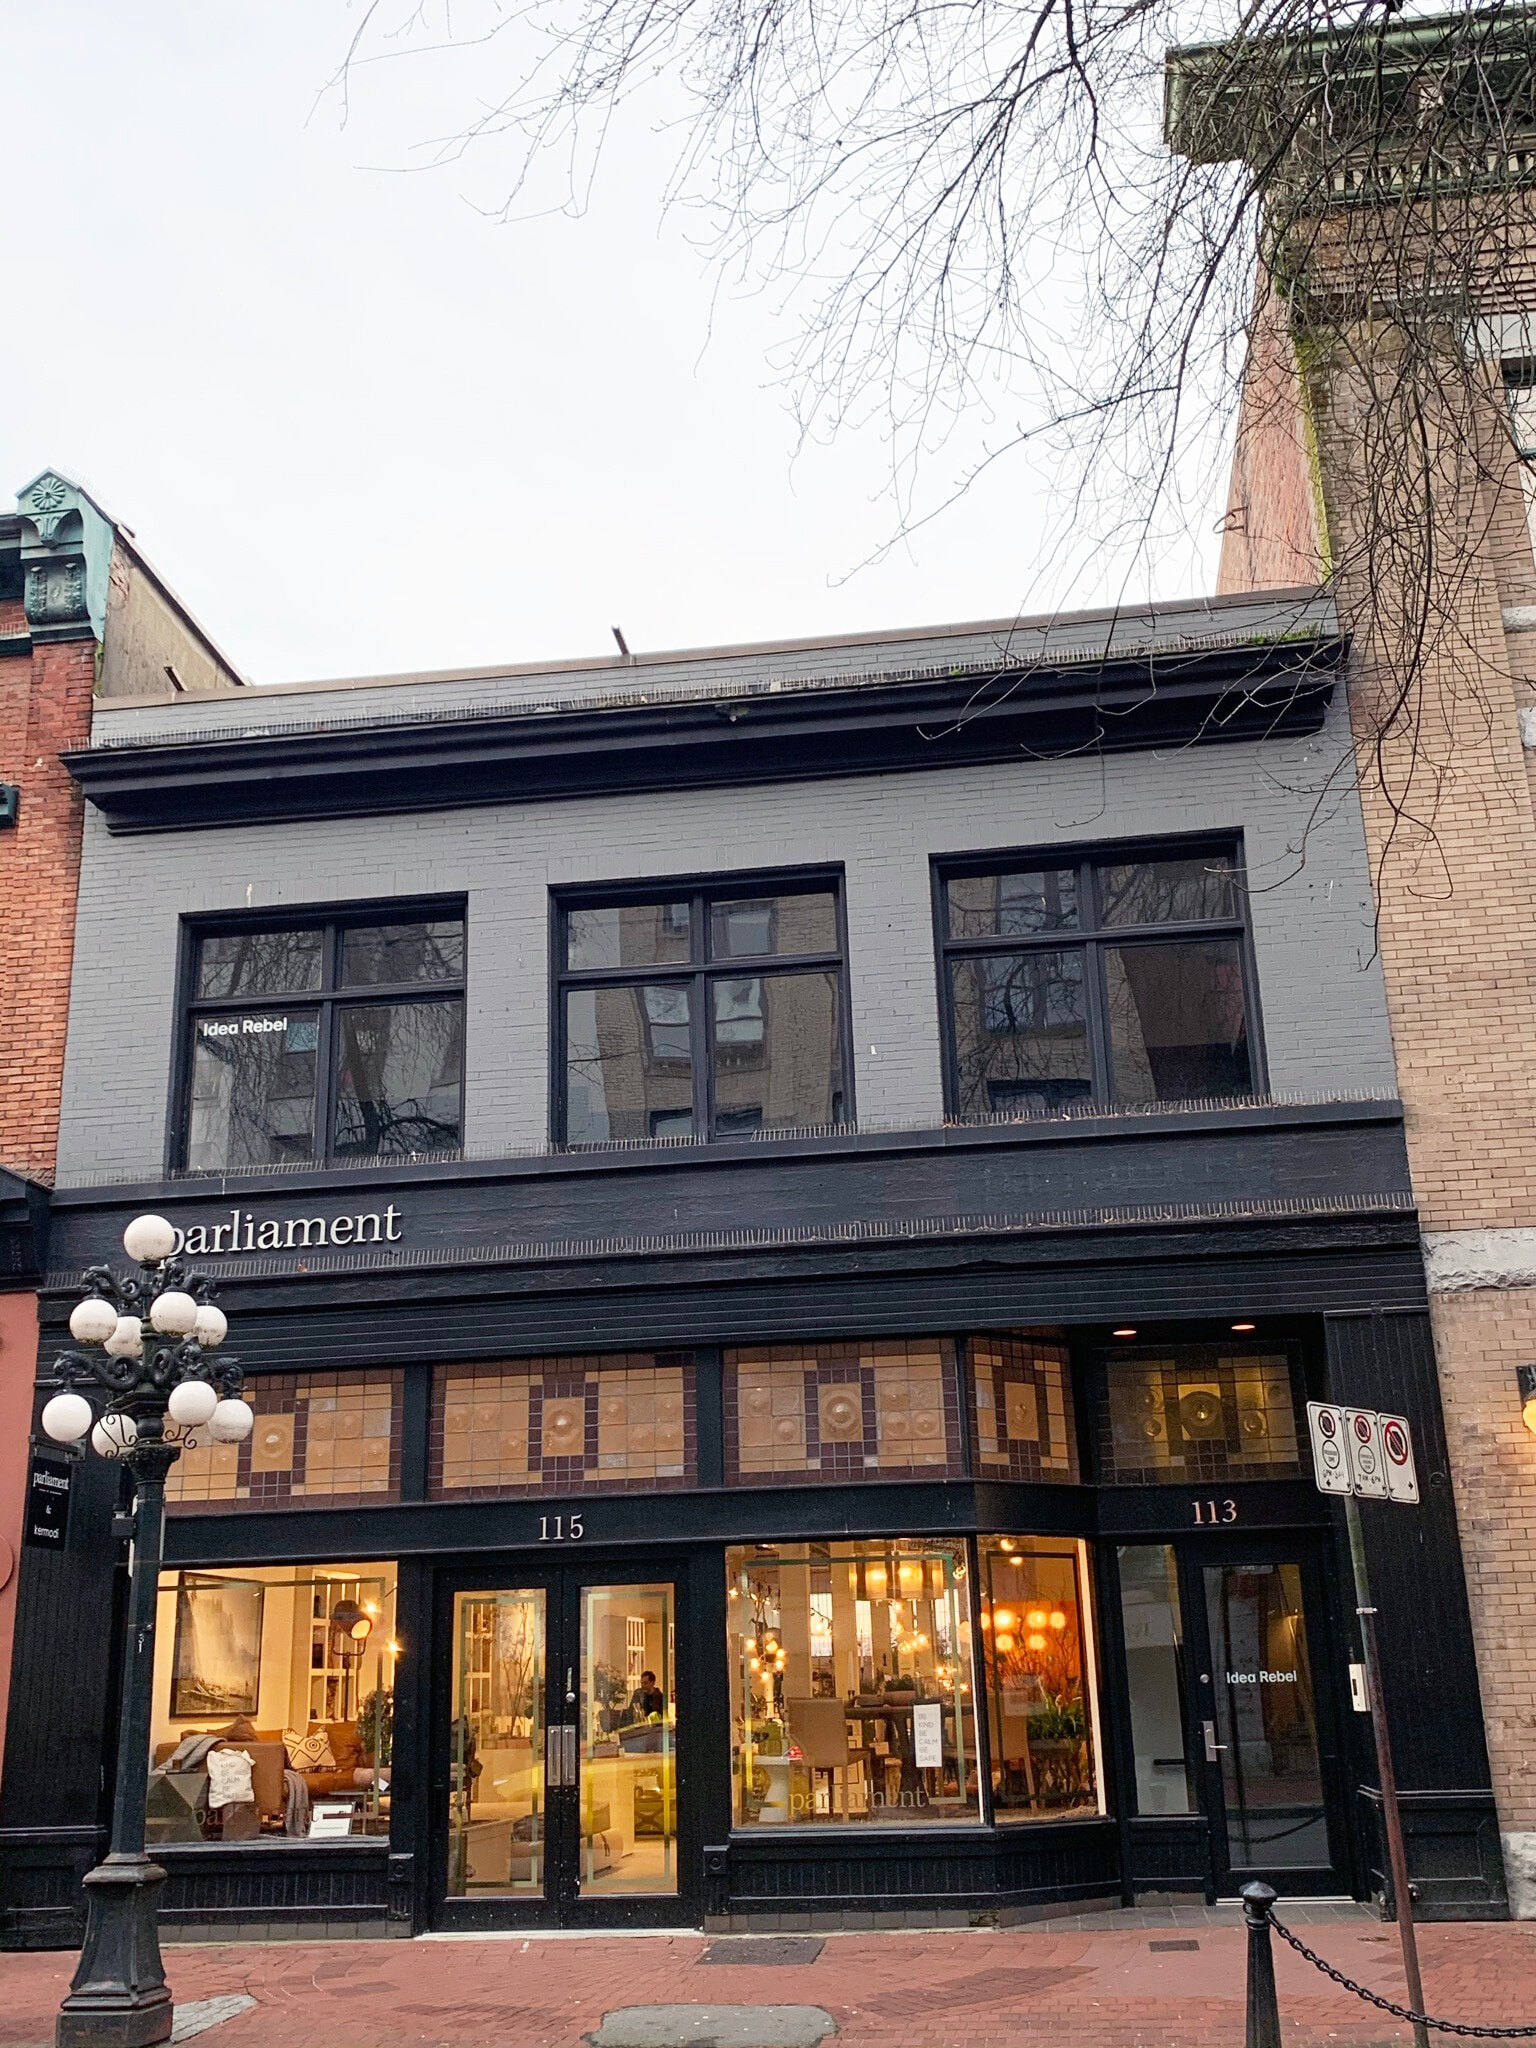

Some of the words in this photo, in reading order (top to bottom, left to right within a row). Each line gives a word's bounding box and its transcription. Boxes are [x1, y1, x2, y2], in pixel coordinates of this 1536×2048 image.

[203, 1022, 239, 1037] Idea
[242, 1017, 288, 1034] Rebel
[33, 1470, 69, 1490] parliament
[1191, 1499, 1237, 1525] 113
[538, 1513, 584, 1541] 115
[1226, 1671, 1257, 1684] Idea
[1259, 1669, 1298, 1683] Rebel
